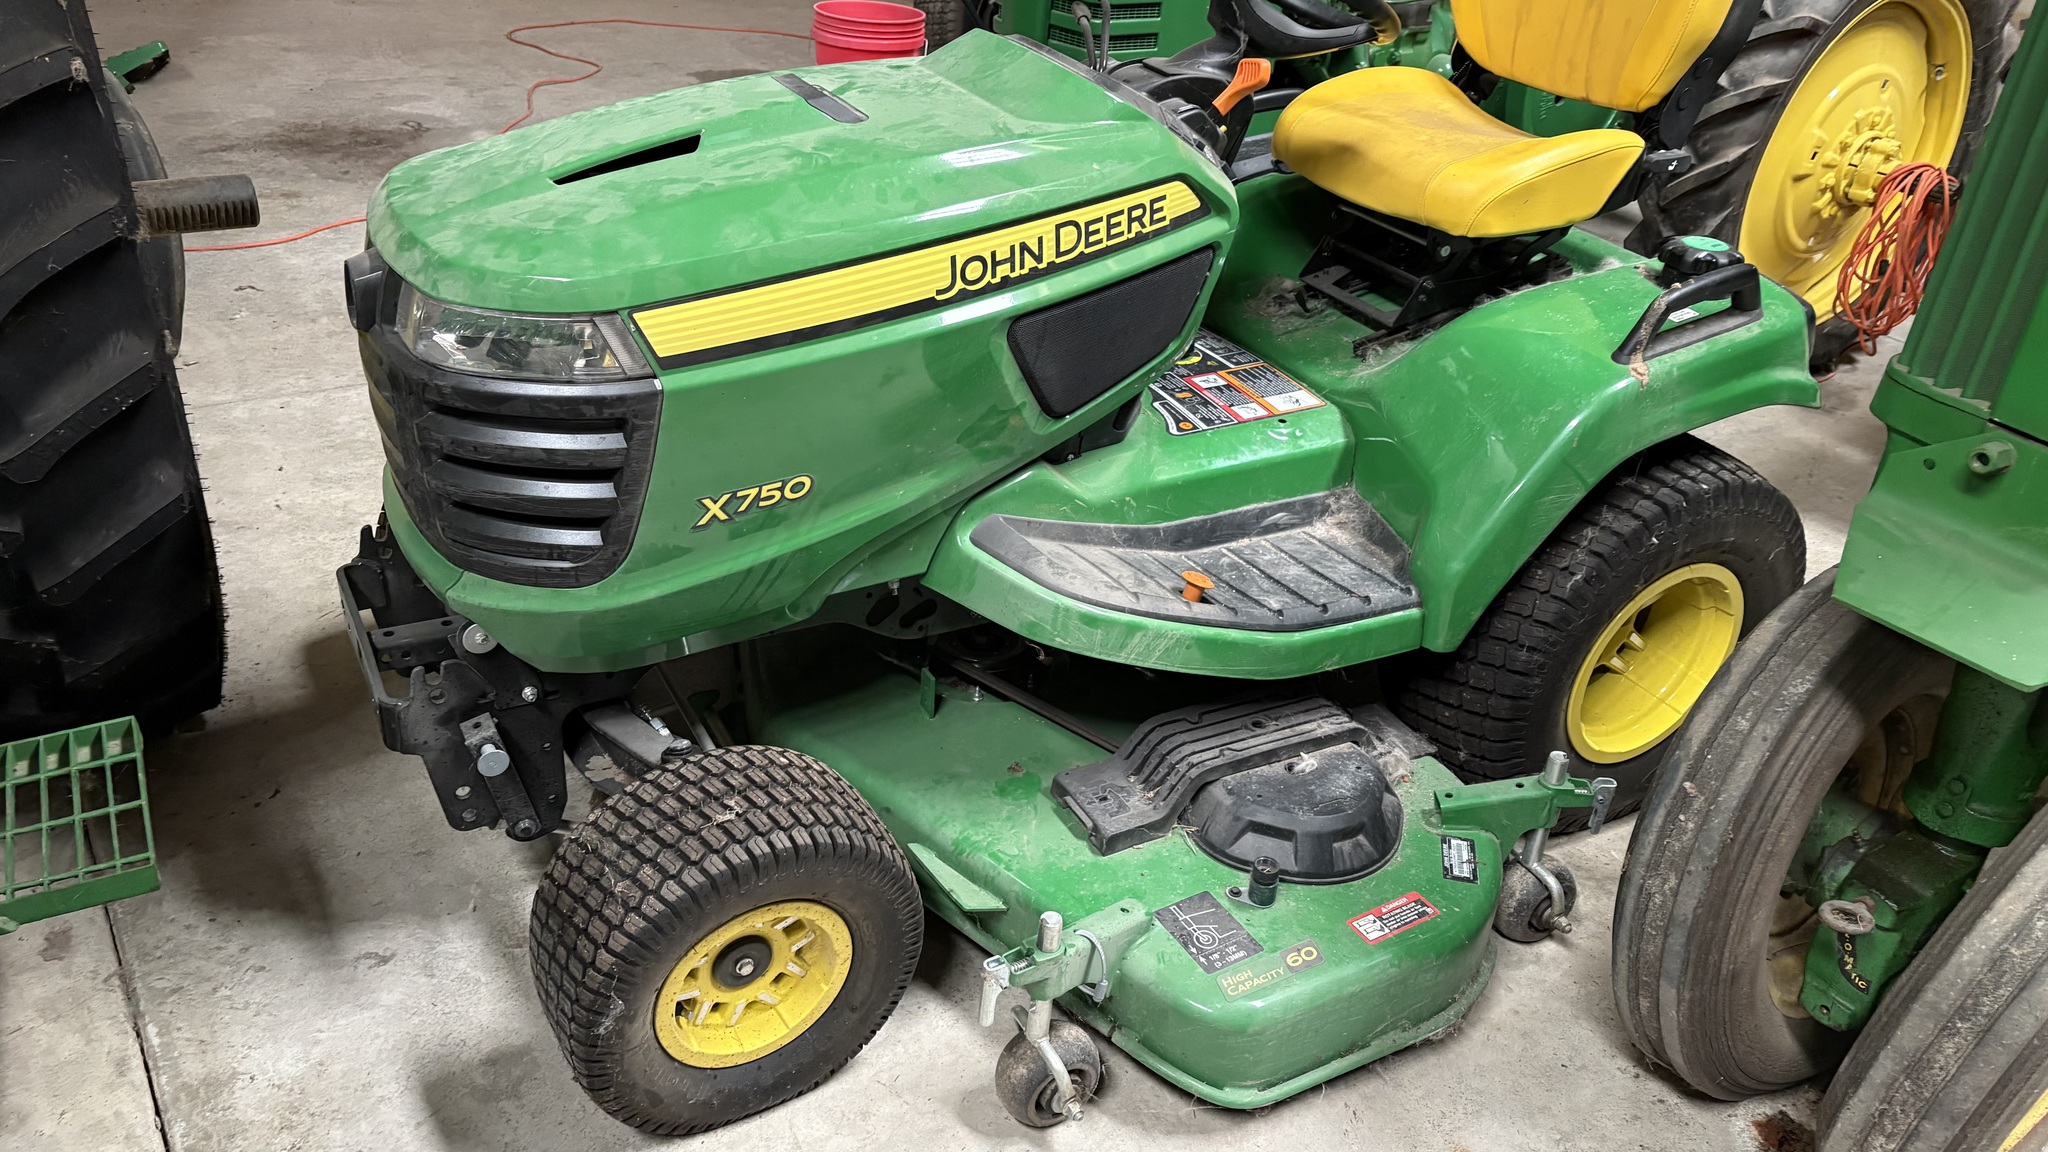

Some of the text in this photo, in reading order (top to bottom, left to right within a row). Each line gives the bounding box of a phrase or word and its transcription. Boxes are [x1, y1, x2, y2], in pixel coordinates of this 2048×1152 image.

[935, 194, 1168, 297] JOHN DEERE
[693, 475, 812, 528] X750
[1385, 897, 1408, 910] DANGER
[1286, 946, 1318, 967] 60
[1221, 969, 1253, 989] HIGH
[1227, 966, 1285, 996] CAPACITY
